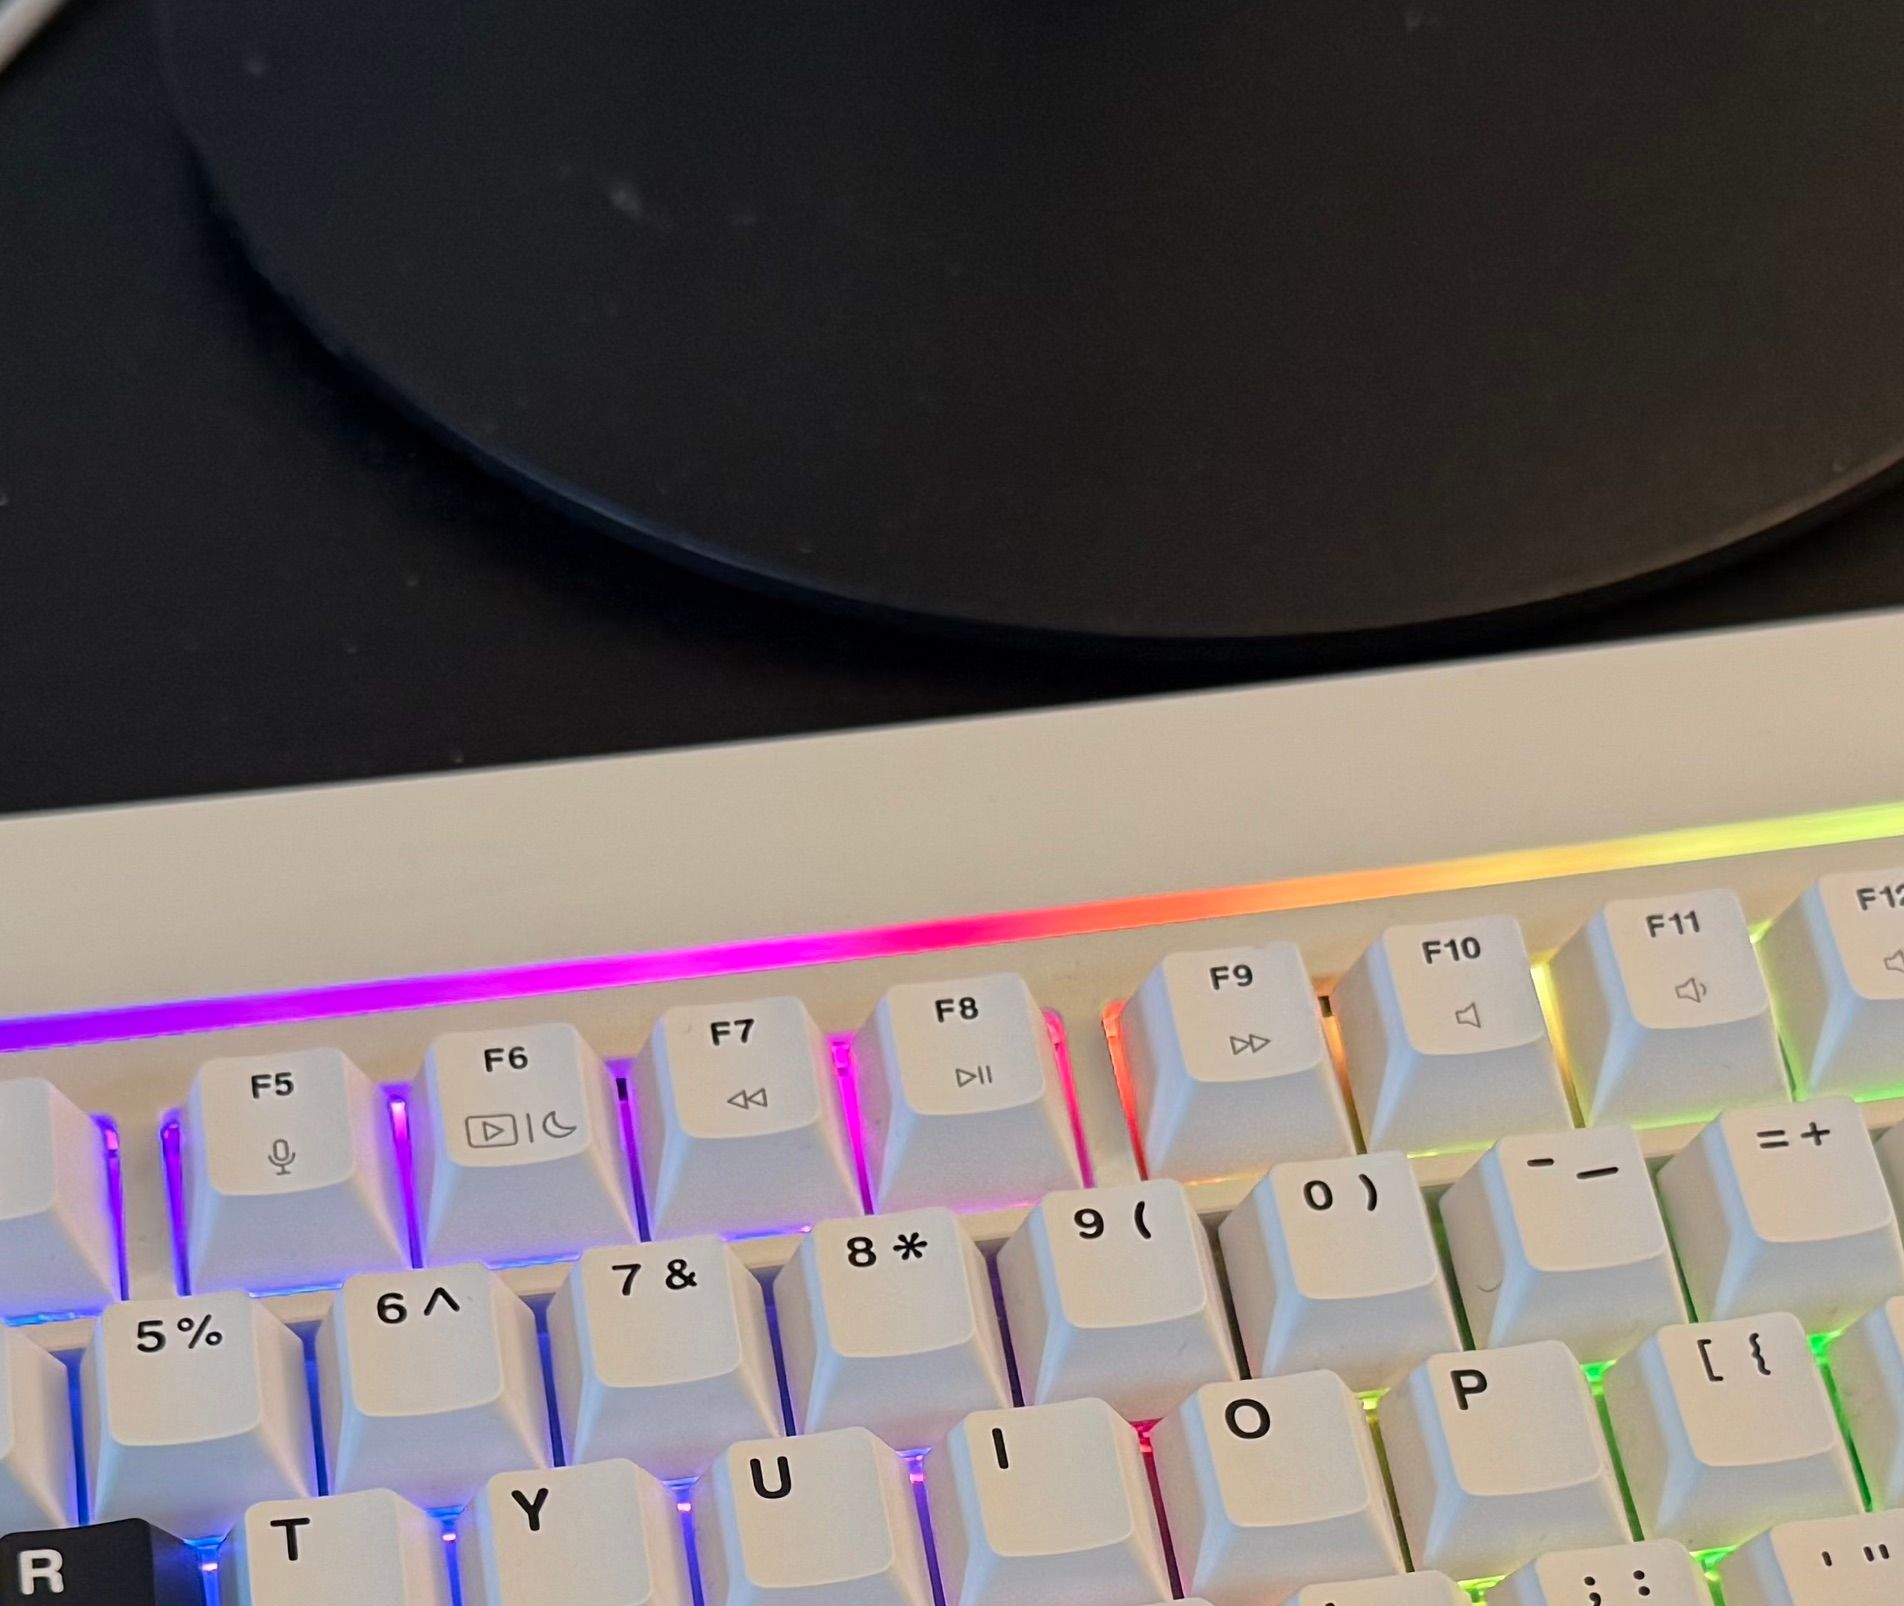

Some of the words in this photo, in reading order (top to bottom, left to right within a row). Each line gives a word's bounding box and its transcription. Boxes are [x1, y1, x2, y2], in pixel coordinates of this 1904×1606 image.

[1645, 910, 1701, 938] F11
[1422, 936, 1482, 965] F10
[1209, 963, 1254, 991] F9
[934, 996, 979, 1023] F8
[709, 1018, 755, 1046] F7
[483, 1045, 529, 1073] F6
[250, 1071, 294, 1099] F5
[1450, 1368, 1488, 1411] P
[1224, 1398, 1271, 1440] O
[749, 1455, 792, 1500] U
[511, 1487, 549, 1532] Y
[269, 1517, 311, 1562] T
[18, 1548, 64, 1596] R
